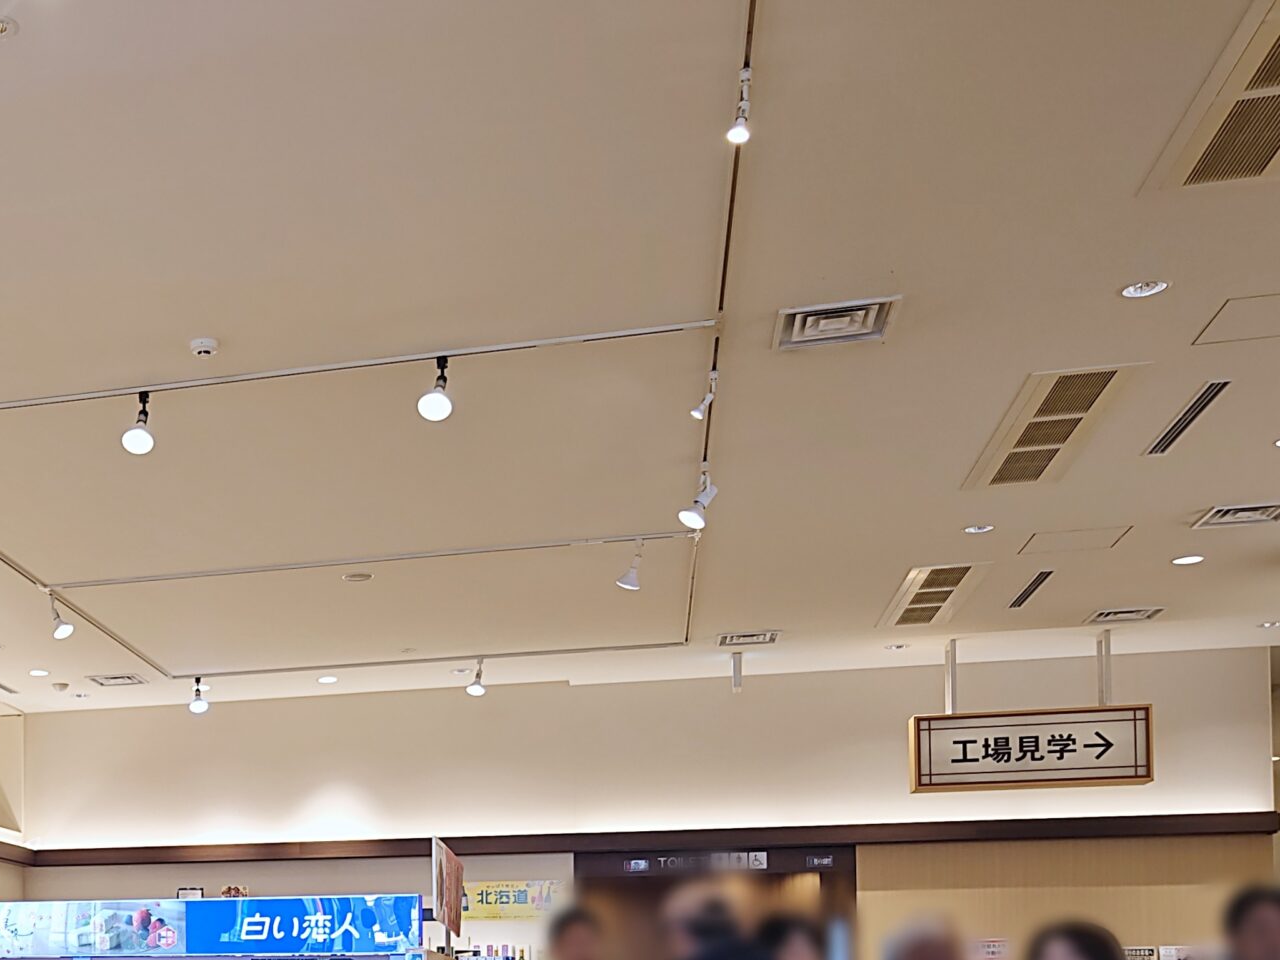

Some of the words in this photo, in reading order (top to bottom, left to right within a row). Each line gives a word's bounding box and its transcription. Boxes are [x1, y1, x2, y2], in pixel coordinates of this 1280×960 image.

[950, 733, 1078, 764] 工場見学
[476, 889, 529, 905] 北海道
[240, 911, 361, 943] 白い恋人
